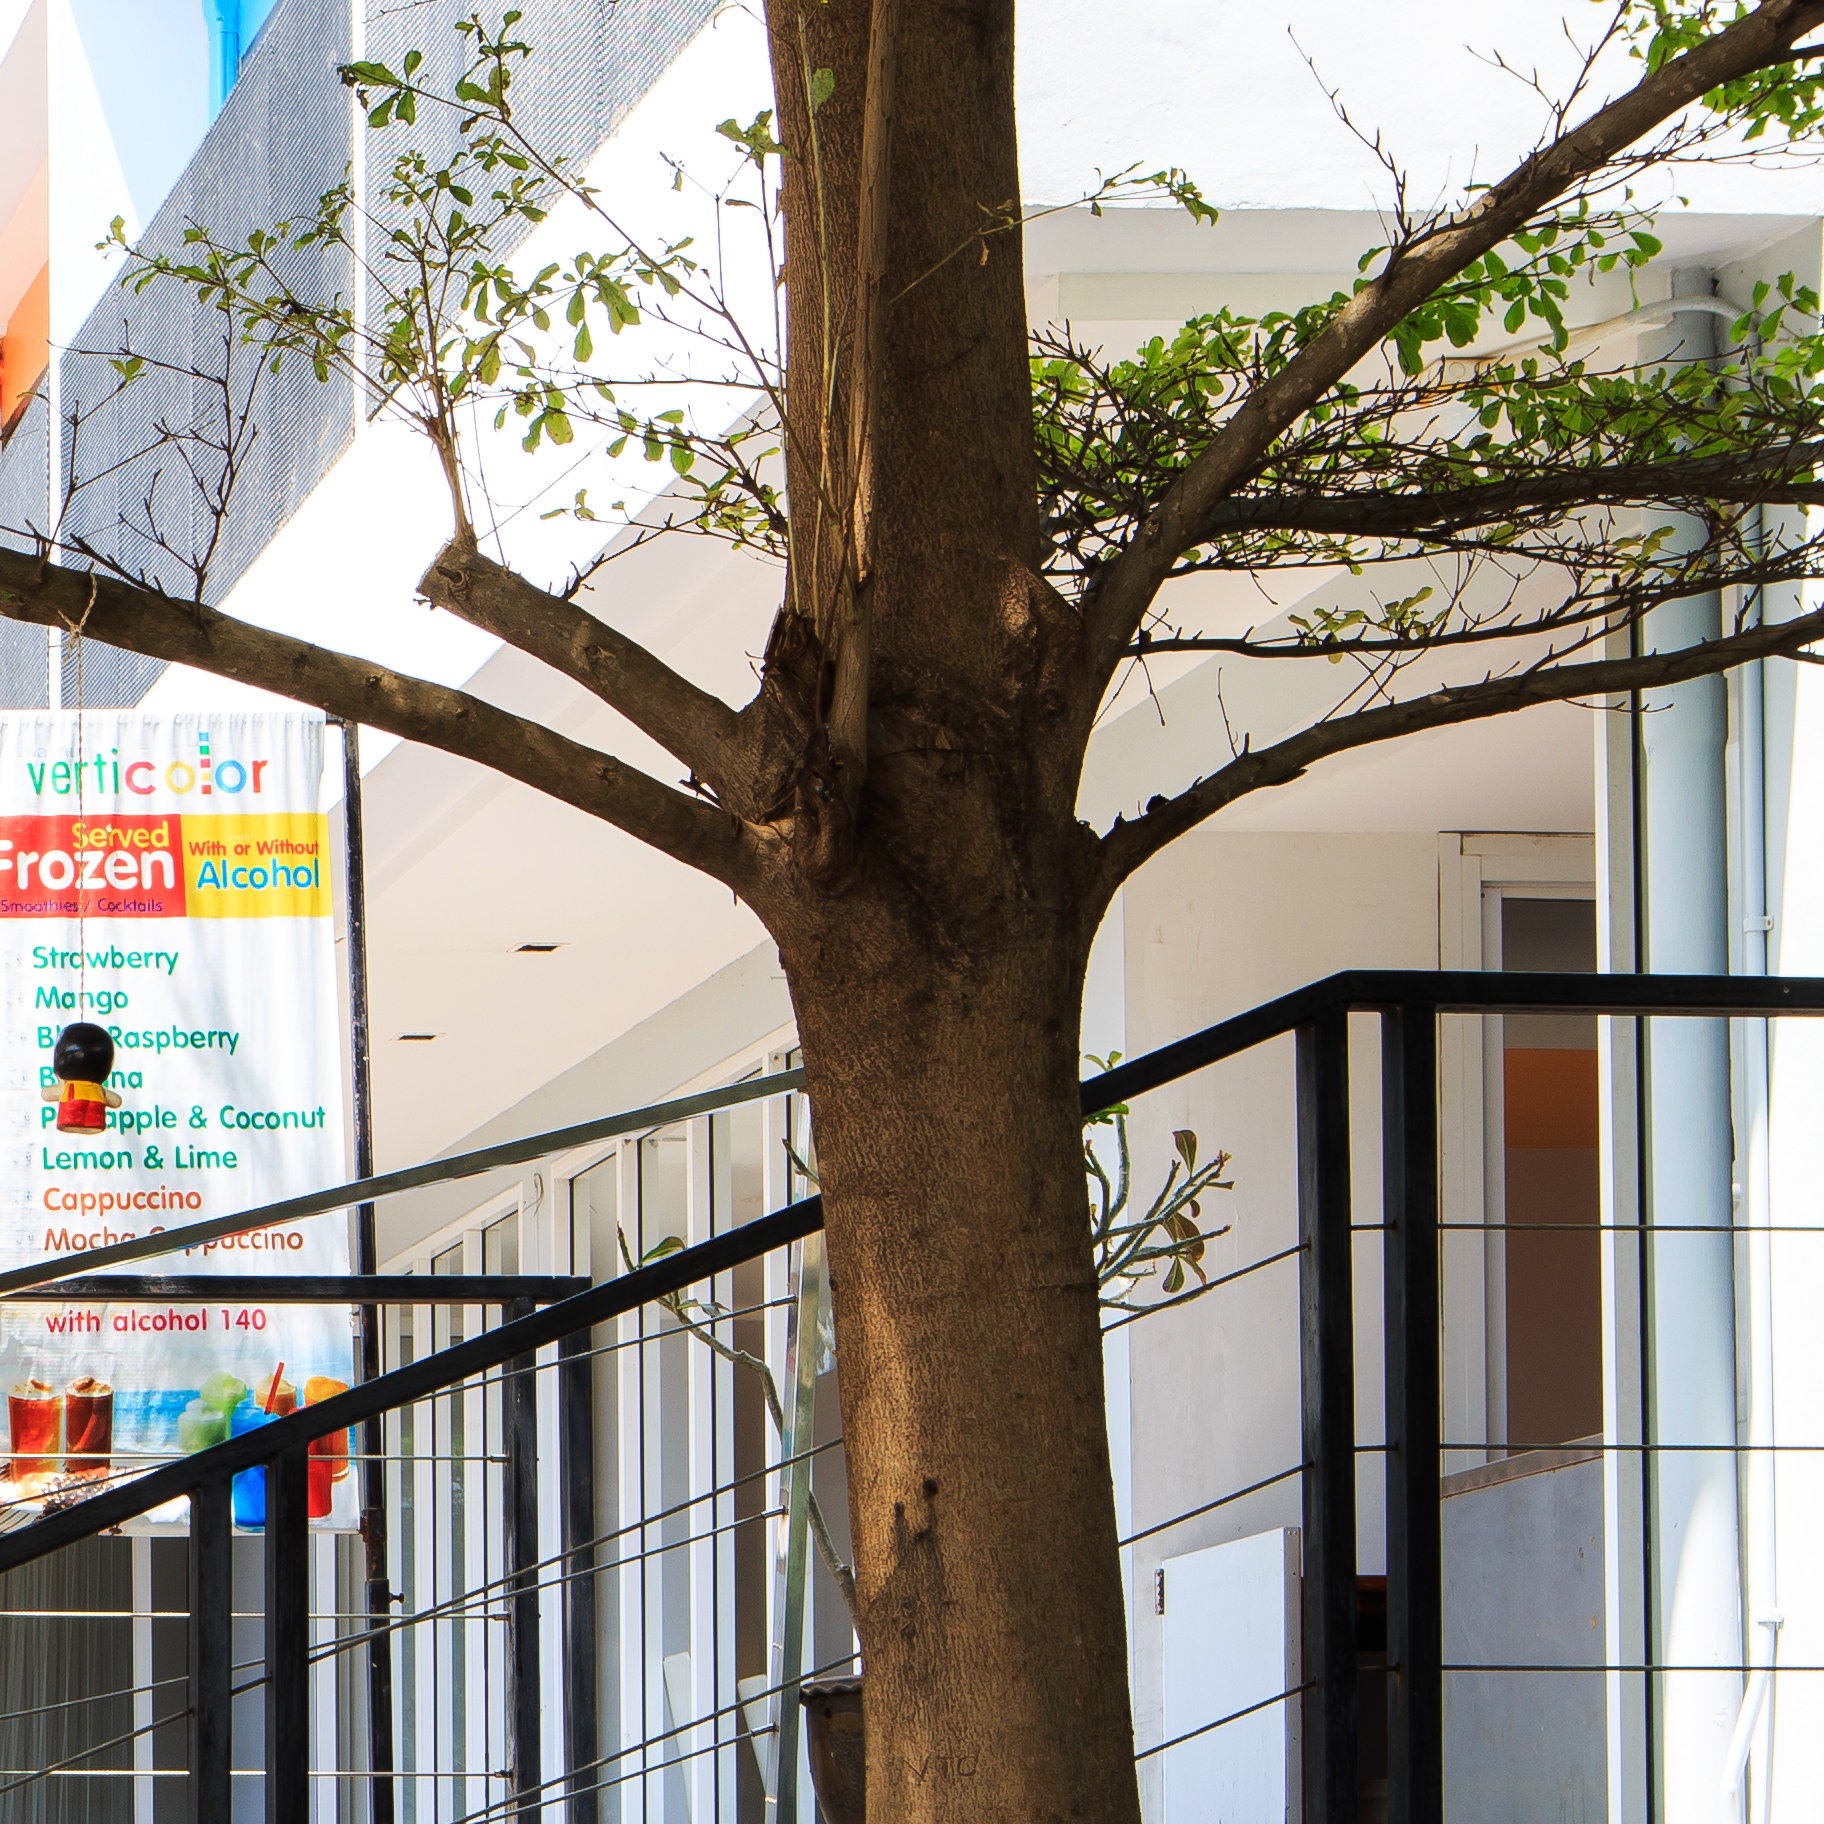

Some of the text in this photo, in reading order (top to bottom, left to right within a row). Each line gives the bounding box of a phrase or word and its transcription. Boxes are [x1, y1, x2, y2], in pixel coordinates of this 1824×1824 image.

[71, 820, 170, 849] Served
[188, 838, 320, 856] With or Without
[197, 857, 320, 890] Alcohol
[0, 899, 79, 913] Smoothies
[97, 897, 164, 913] Cocktails
[32, 944, 179, 976] Strawberry
[35, 986, 129, 1015] Mango
[108, 1024, 240, 1056] Raspberry
[39, 1066, 143, 1089] Bna
[41, 1104, 327, 1135] Papple & Coconut
[43, 1144, 238, 1170] Lemon & Lime
[43, 1184, 202, 1217] Cappuccino
[45, 1307, 267, 1333] with alcohol 140
